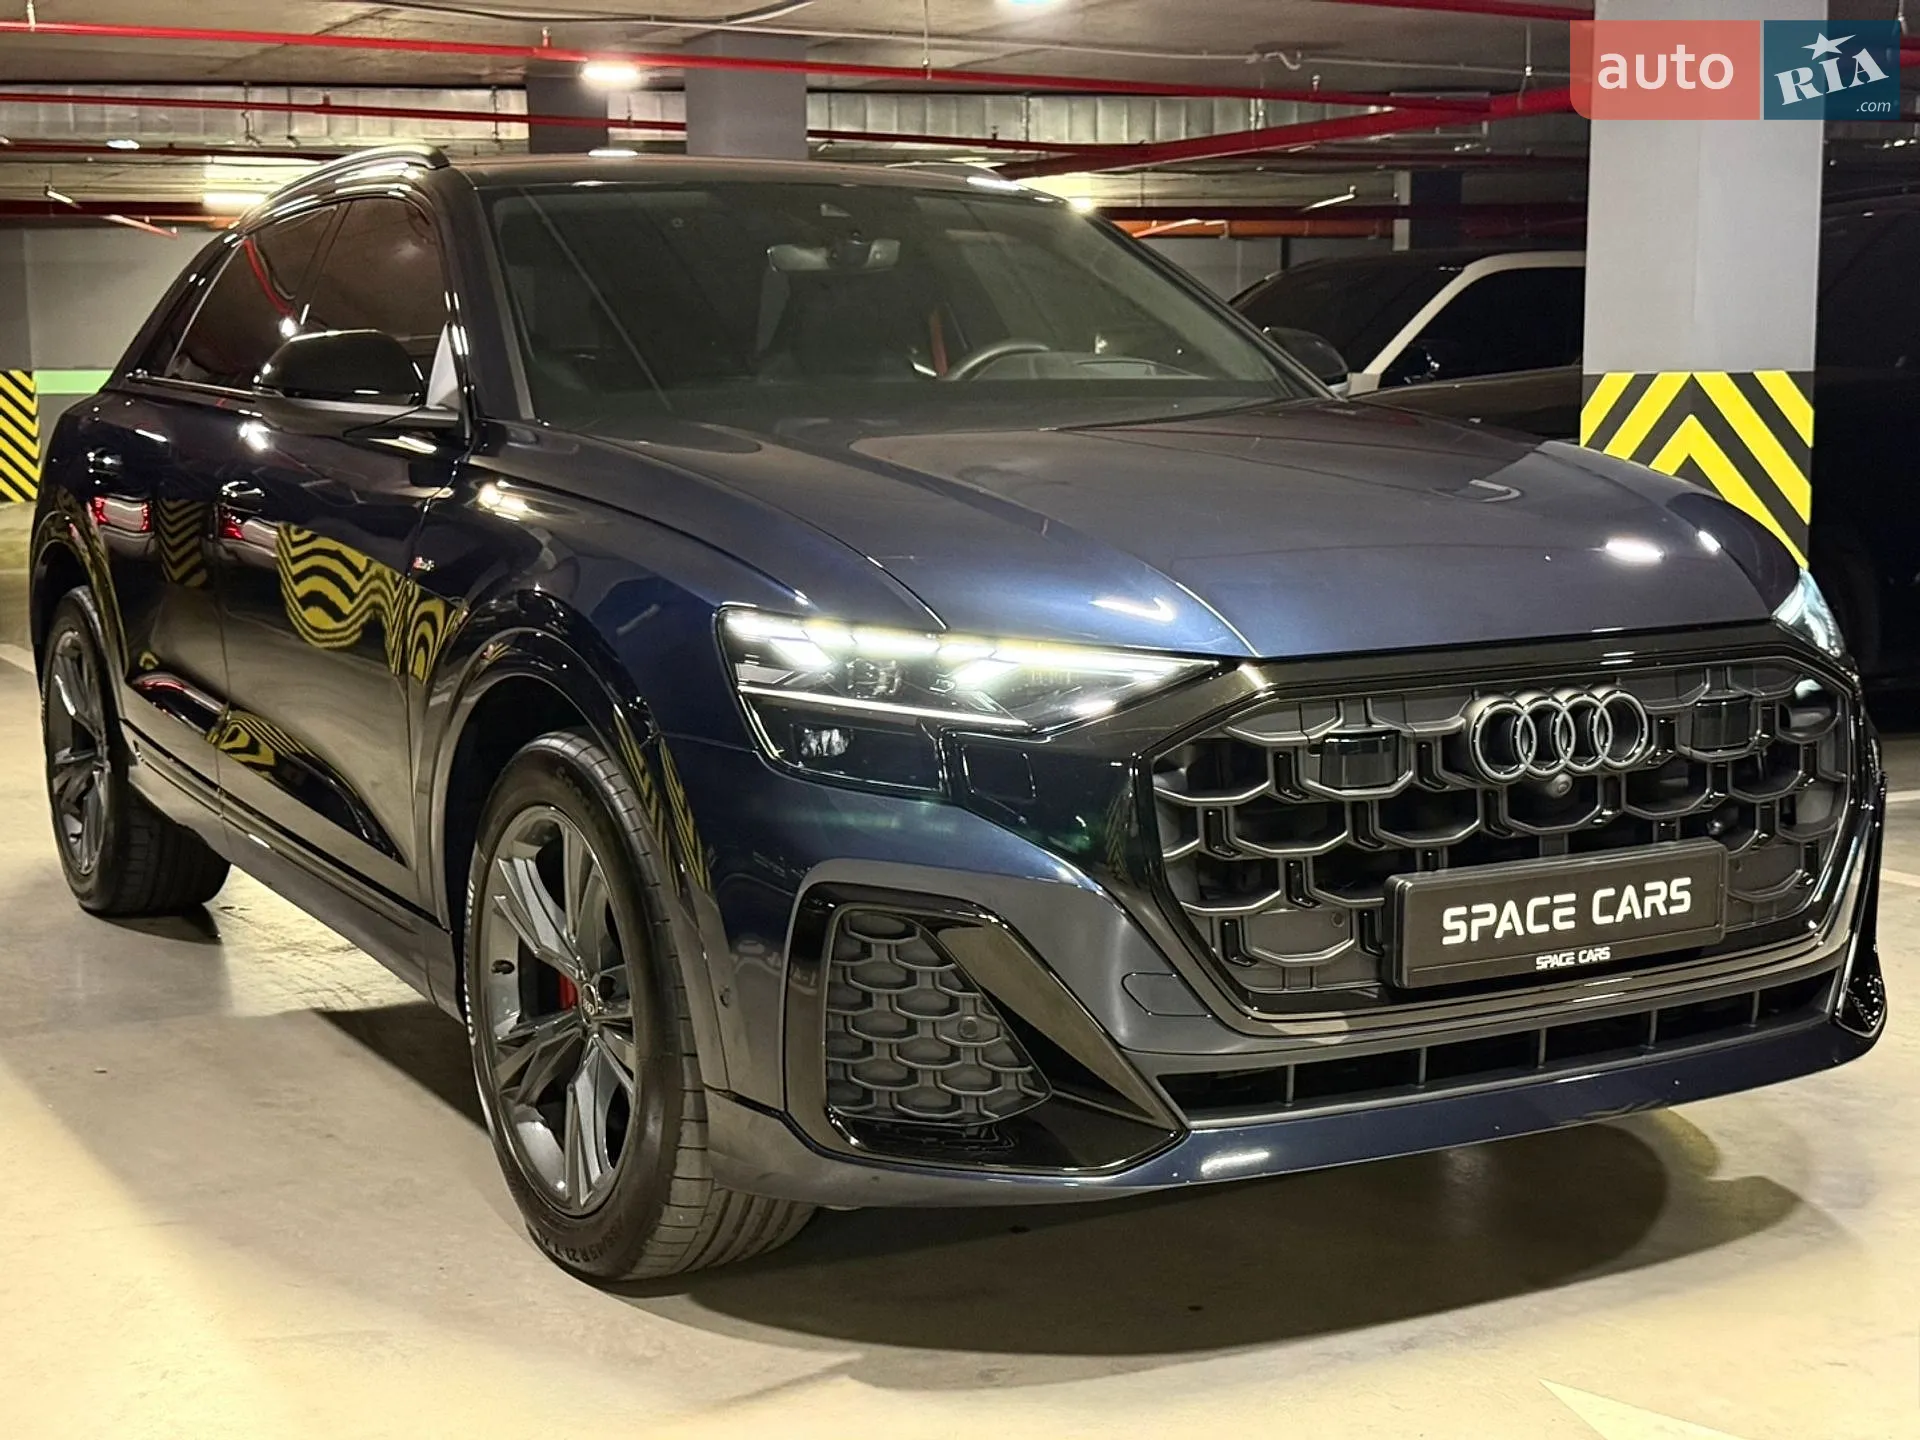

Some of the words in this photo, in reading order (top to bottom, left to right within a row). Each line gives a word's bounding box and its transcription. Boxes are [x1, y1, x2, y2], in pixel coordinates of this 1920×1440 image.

[1441, 892, 1577, 946] SPACE
[1591, 876, 1692, 926] CARS
[1535, 951, 1576, 971] SPACE
[1578, 946, 1612, 964] CARS
